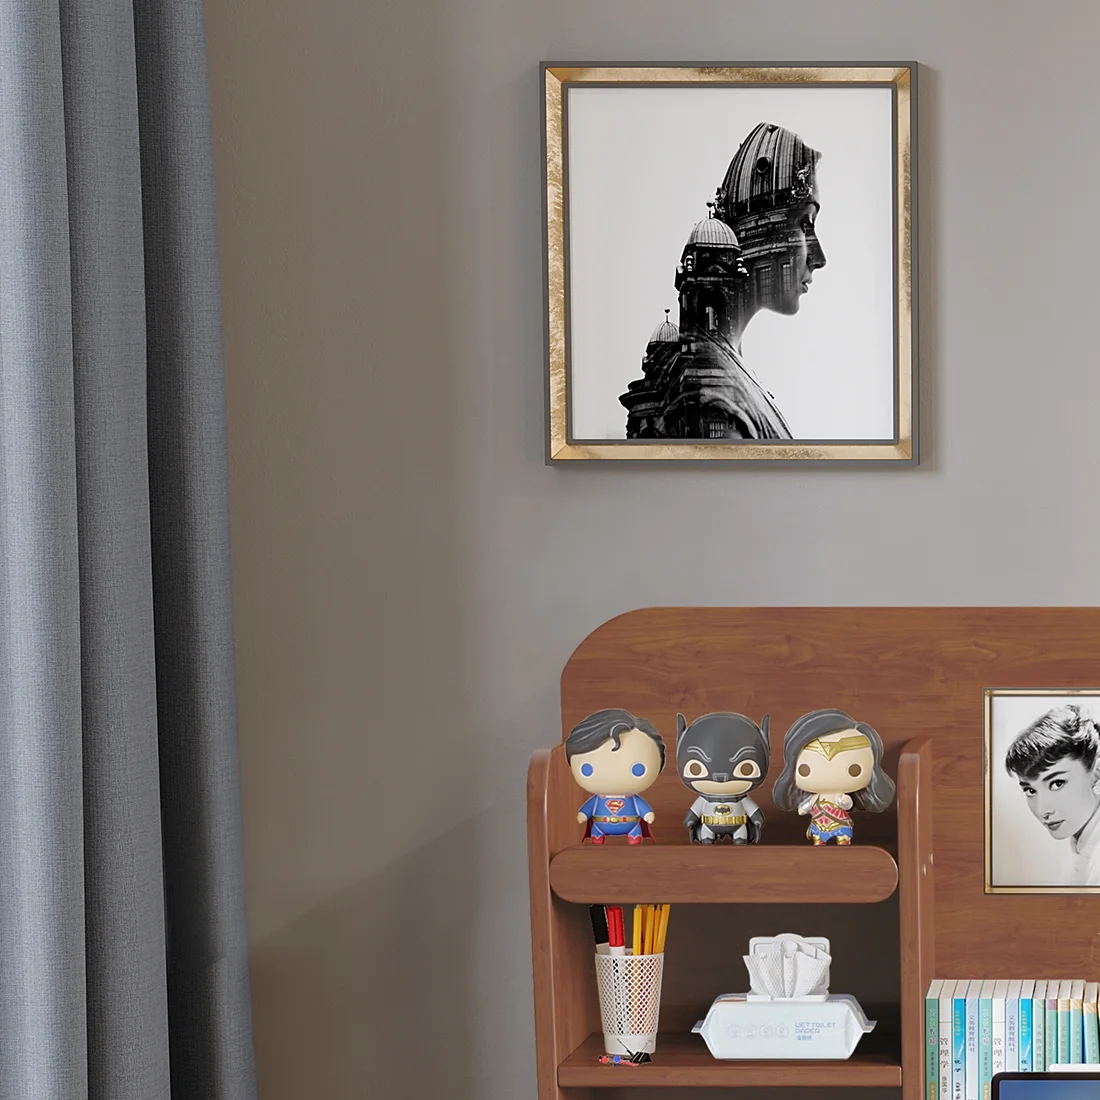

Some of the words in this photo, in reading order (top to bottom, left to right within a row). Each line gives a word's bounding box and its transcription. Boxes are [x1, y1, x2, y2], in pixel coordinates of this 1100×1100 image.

[940, 1037, 950, 1069] 管理学
[993, 1037, 1003, 1069] 管理学
